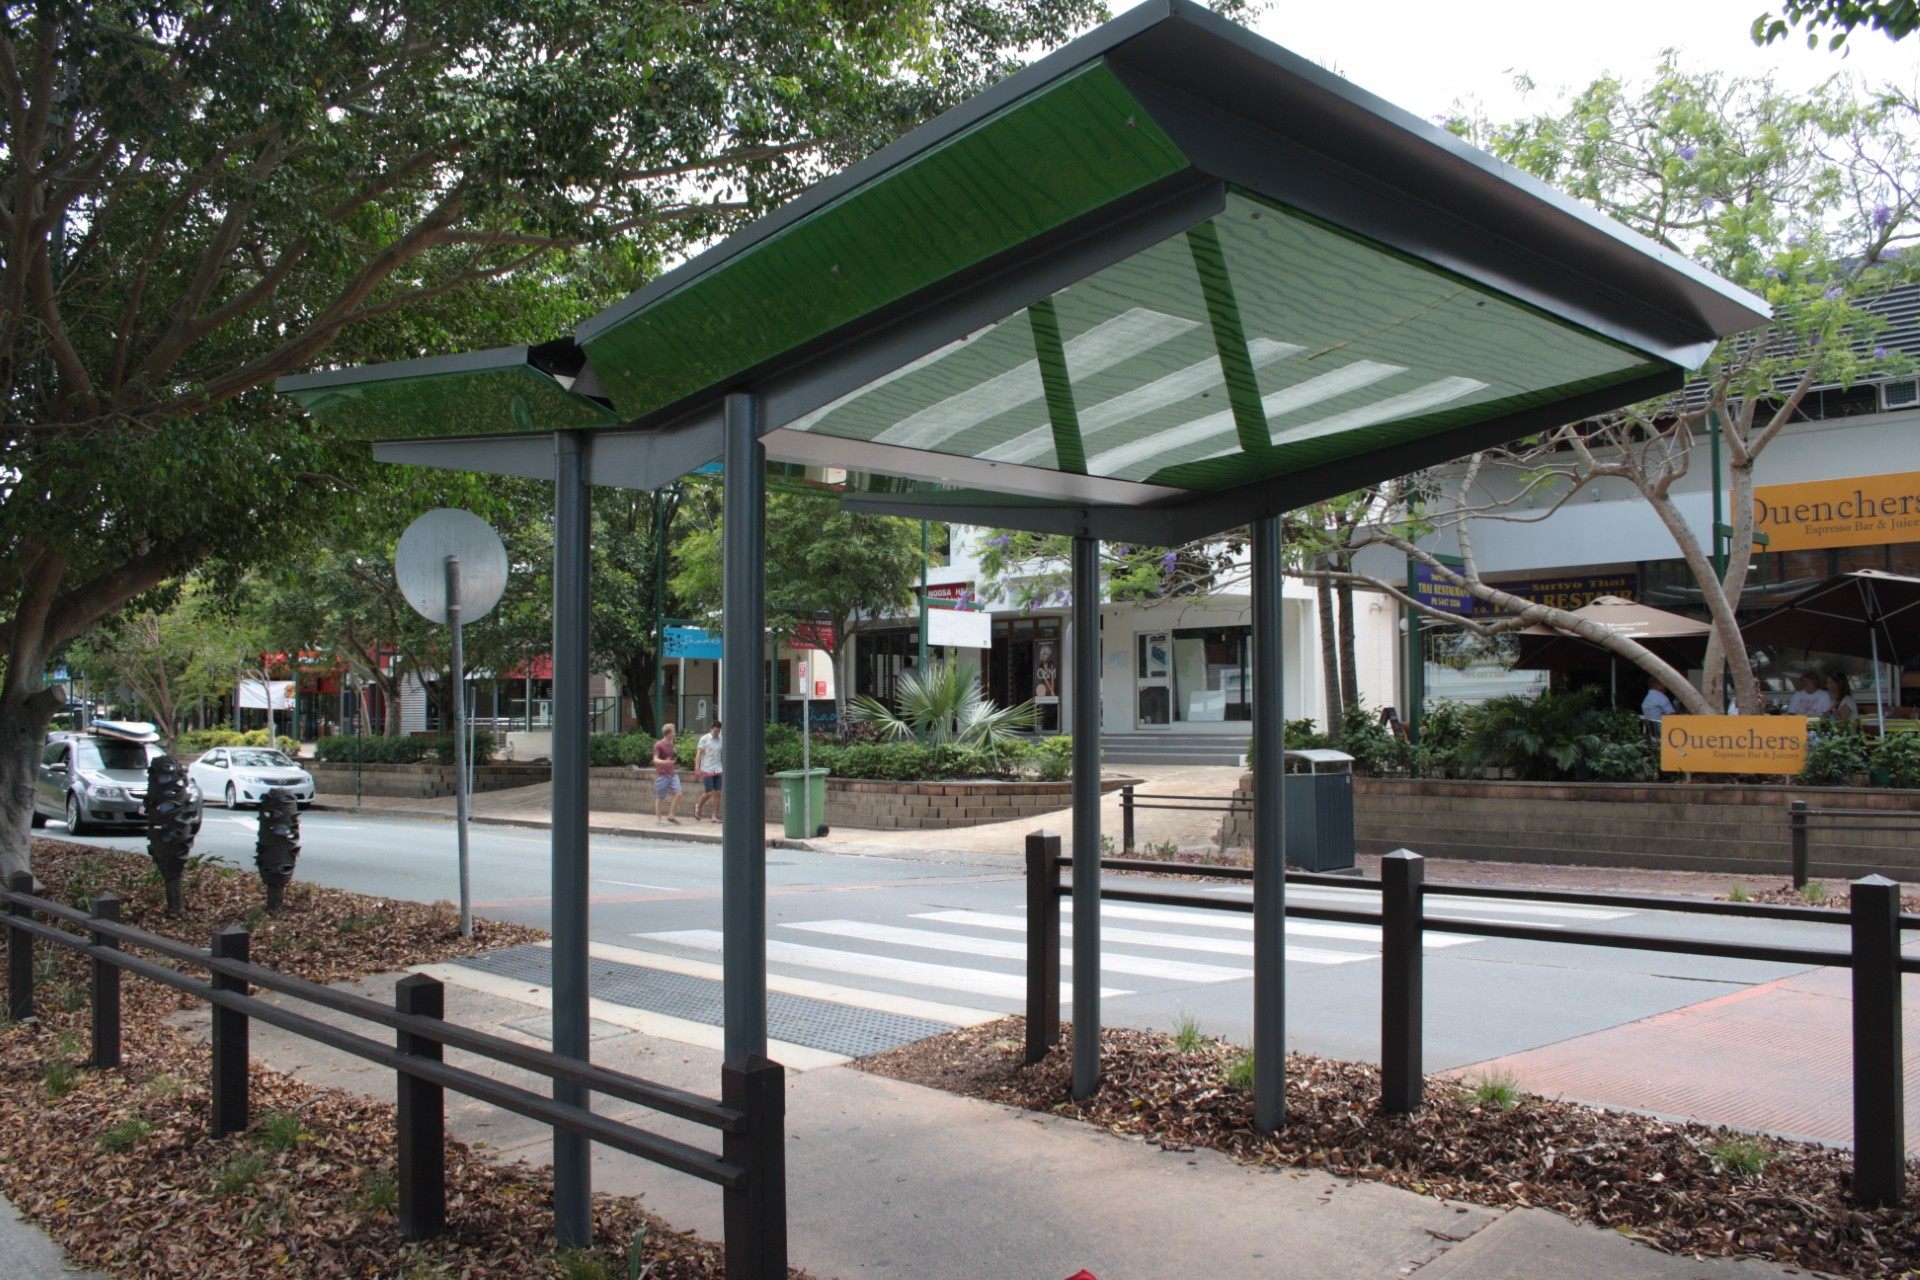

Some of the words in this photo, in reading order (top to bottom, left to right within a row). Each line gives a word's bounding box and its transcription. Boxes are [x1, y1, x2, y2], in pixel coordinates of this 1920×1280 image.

[1805, 525, 1850, 537] Espresso
[1855, 521, 1873, 531] Bar
[1877, 521, 1886, 530] &
[1890, 517, 1920, 531] Juice
[1588, 577, 1626, 587] Thai
[928, 589, 951, 597] NOOSA
[1668, 727, 1800, 754] Quenchers
[1714, 751, 1745, 760] Espresso
[1748, 751, 1760, 759] Bar
